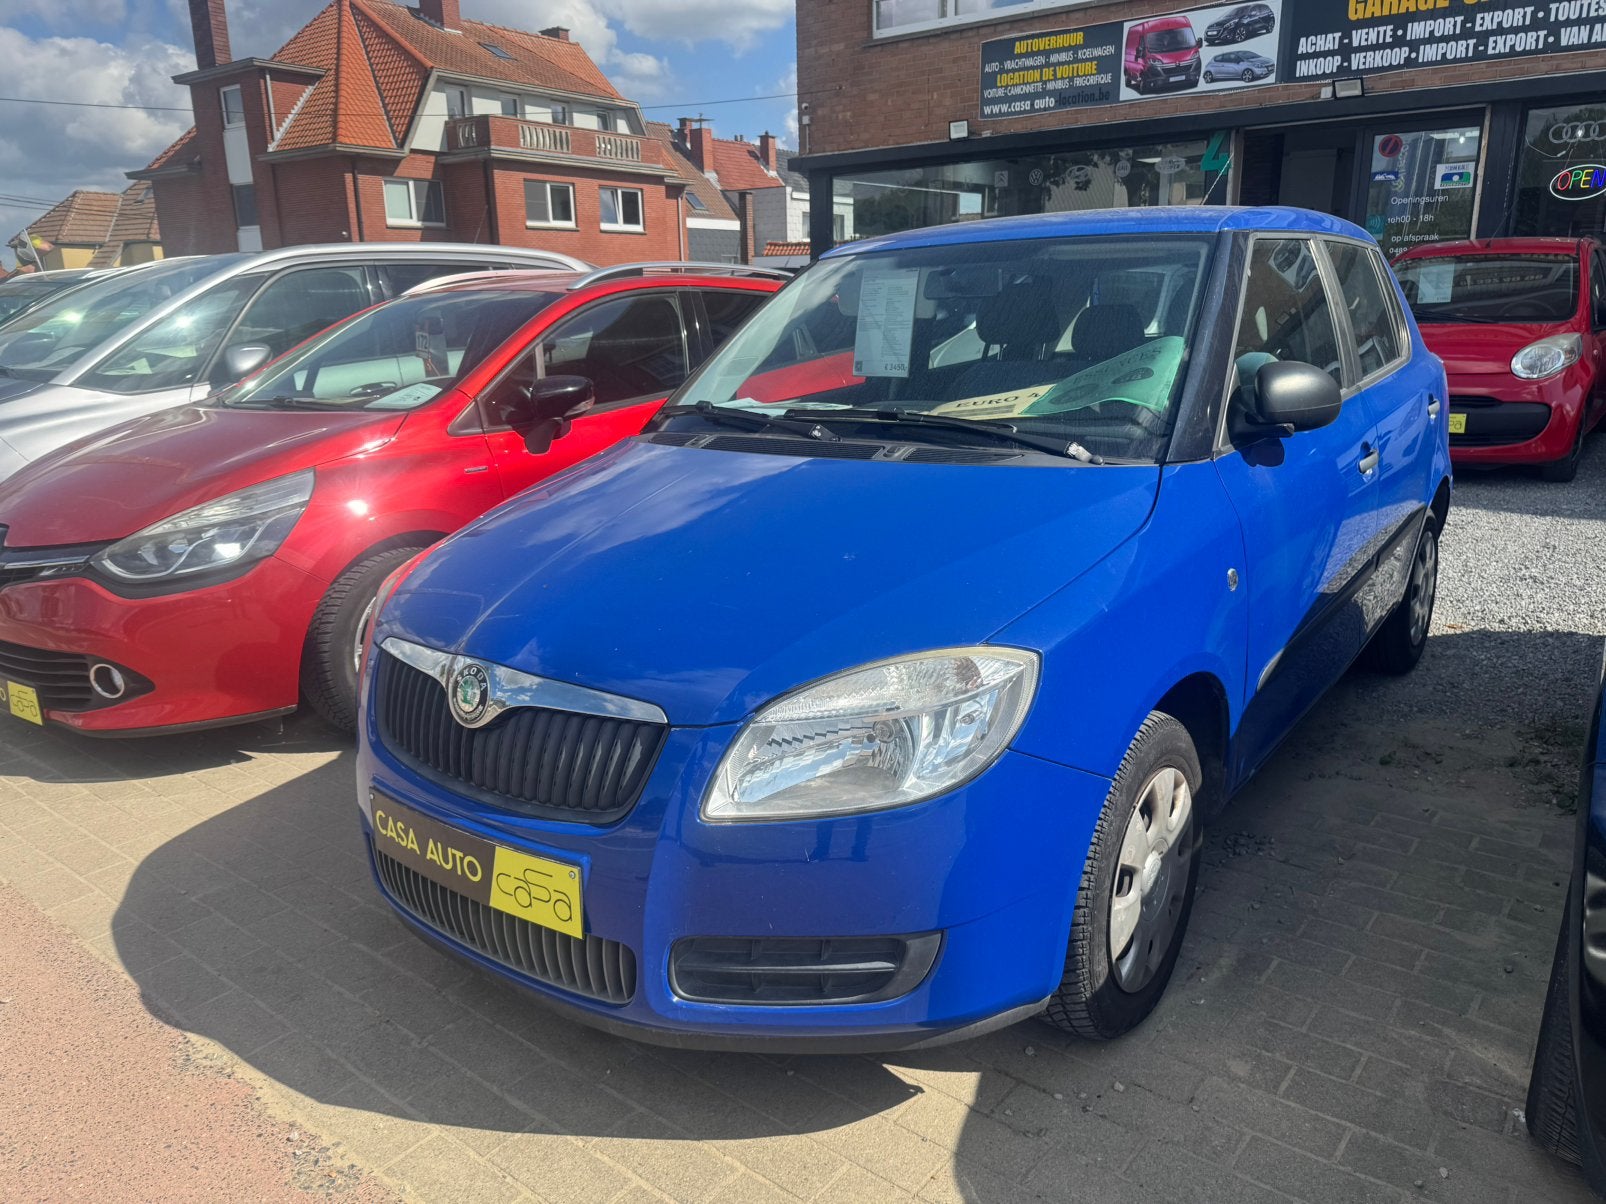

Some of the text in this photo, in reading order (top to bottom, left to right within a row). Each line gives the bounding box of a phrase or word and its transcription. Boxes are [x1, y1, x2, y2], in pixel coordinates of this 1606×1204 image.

[1348, 0, 1449, 20] GARA
[1298, 32, 1341, 54] ACHAT
[1352, 25, 1393, 47] VENTE
[1406, 16, 1464, 40] IMPORT
[1475, 6, 1534, 32] EXPORT
[1014, 32, 1084, 54] AUTOVERHUUR
[1296, 55, 1341, 77] INKOOP
[1351, 47, 1409, 70] VERKOOP
[1418, 39, 1476, 63] IMPORT
[1487, 30, 1547, 55] EXPORT
[1560, 24, 1590, 46] VAN
[985, 45, 1115, 73] AUTO VRACHTWAGEN MINIBUS KOELWAGEN
[996, 61, 1097, 87] LOCATION DE VOITURE
[1046, 79, 1069, 91] MINIBUS
[1074, 73, 1112, 87] FRIGORIFIQUE
[1557, 169, 1606, 190] OPEN
[1391, 195, 1449, 206] Openingsuren
[1419, 214, 1434, 222] 18h
[1404, 233, 1440, 242] afspraak
[957, 396, 1019, 408] EURO
[375, 810, 420, 855] CASA
[426, 839, 482, 882] AUTO
